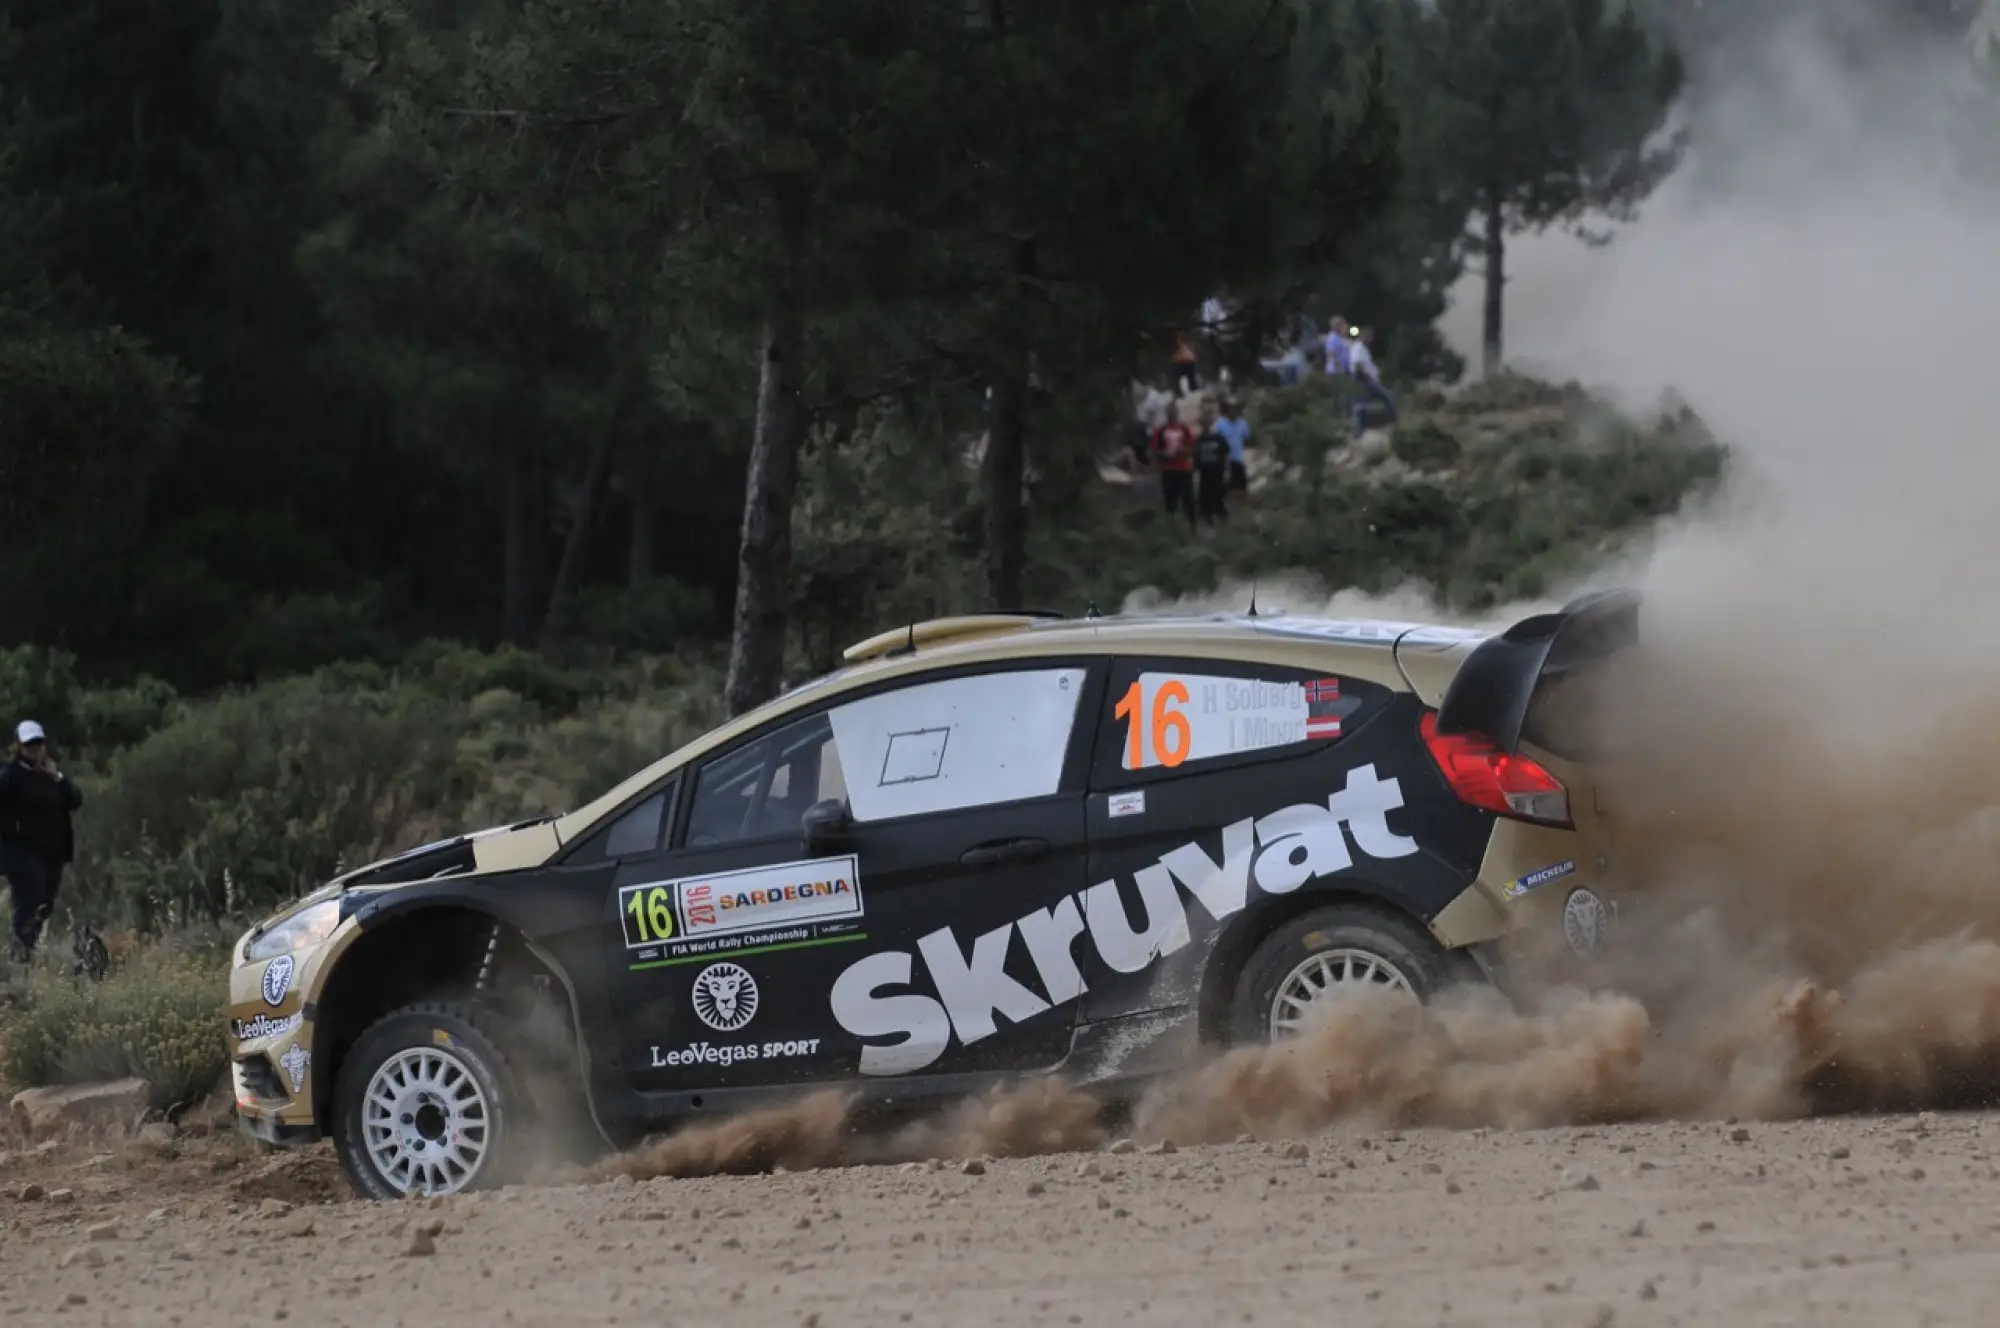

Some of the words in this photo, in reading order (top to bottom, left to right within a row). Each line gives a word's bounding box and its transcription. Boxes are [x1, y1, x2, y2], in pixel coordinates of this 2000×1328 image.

[1203, 684, 1217, 714] H
[1115, 680, 1191, 769] 16
[1527, 861, 1574, 885] MICHELIN
[686, 884, 717, 927] 2016
[719, 879, 850, 910] SARDEGNA
[627, 886, 673, 942] 16
[672, 943, 688, 955] FIA
[690, 938, 718, 952] World
[719, 935, 742, 952] Rally
[744, 928, 809, 945] Championship
[237, 1015, 291, 1041] LeoVegas
[650, 1042, 758, 1067] LeoVegas
[762, 1038, 820, 1059] SPORT
